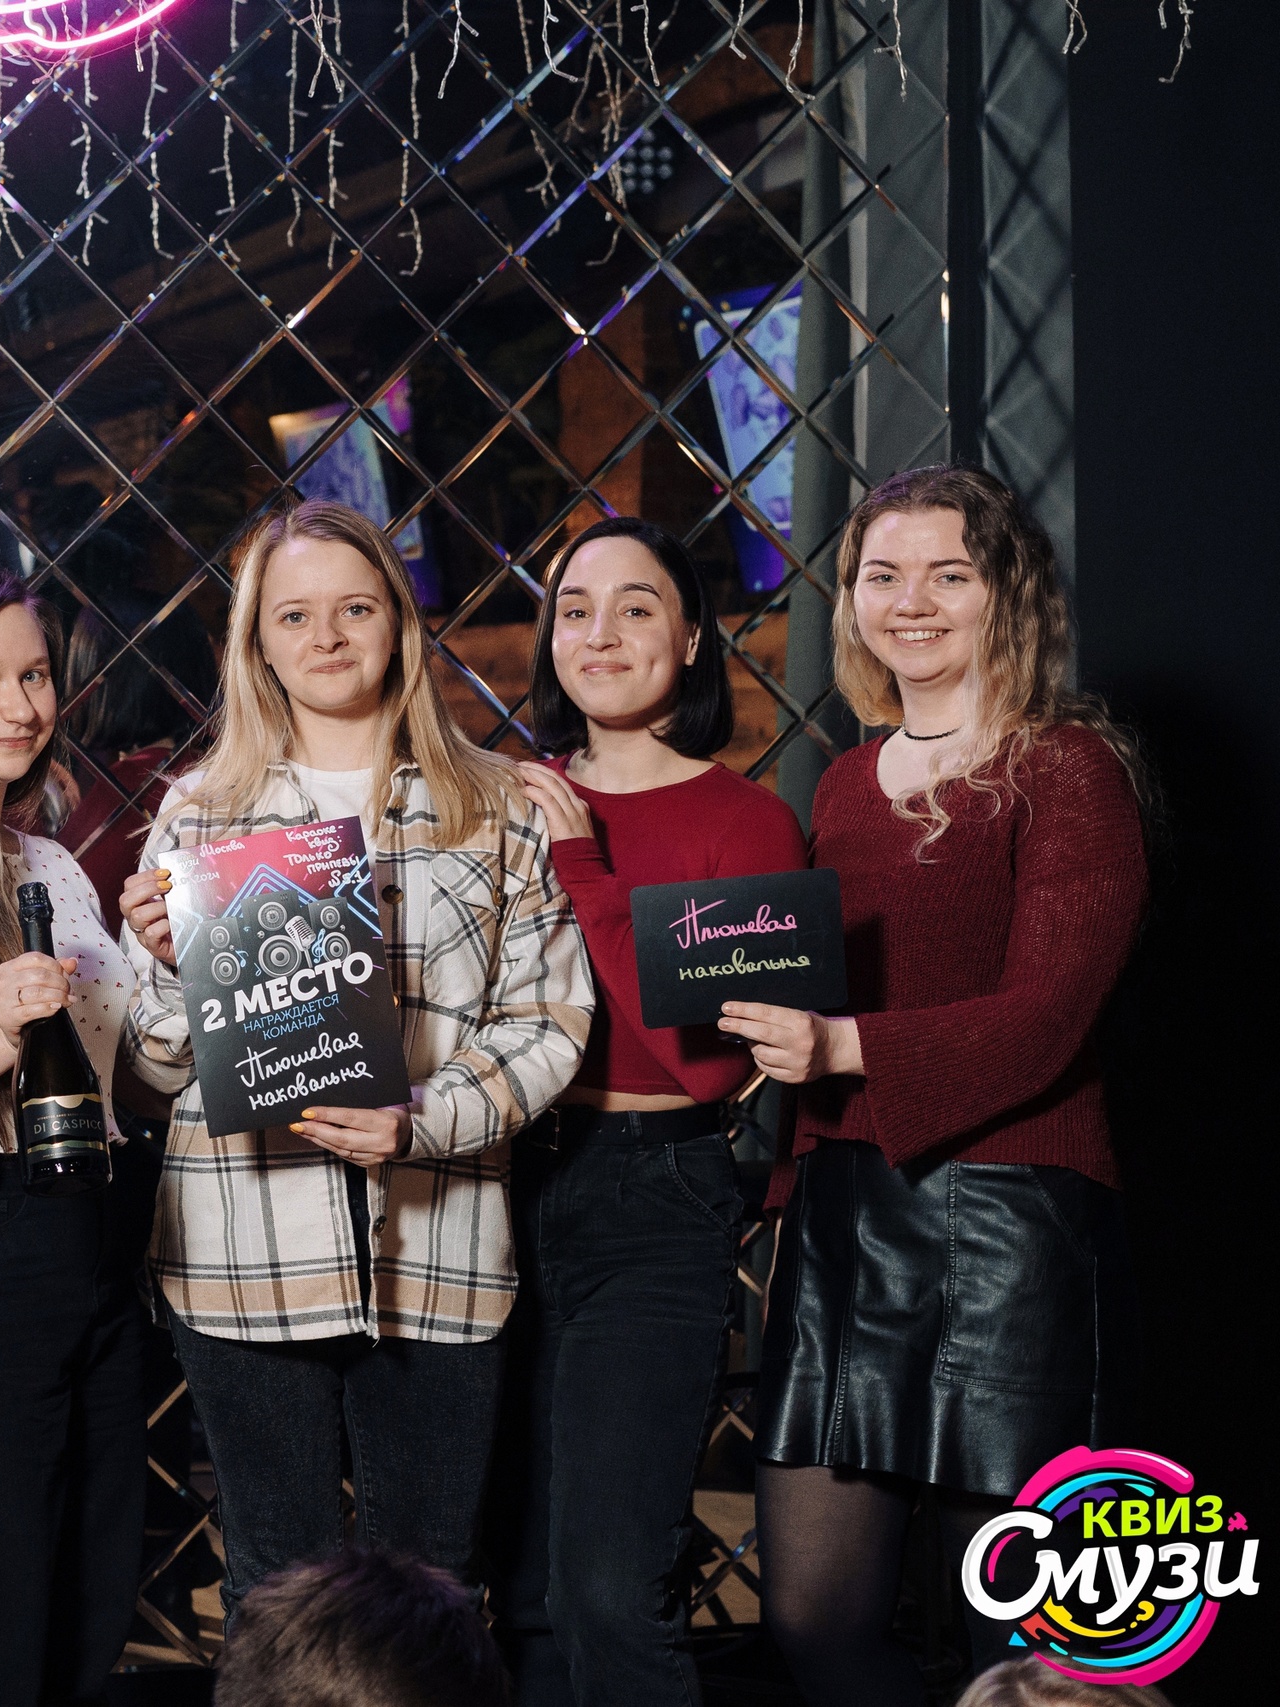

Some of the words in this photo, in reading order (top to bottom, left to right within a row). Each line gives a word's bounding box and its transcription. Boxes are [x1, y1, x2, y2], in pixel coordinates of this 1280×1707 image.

[199, 839, 246, 858] Москва
[669, 898, 798, 950] Плюшевая
[679, 947, 812, 981] наковальня
[200, 998, 227, 1033] 2
[234, 951, 374, 1023] МЕСТО
[243, 993, 340, 1033] НАГРАЖДАЕТСЯ
[262, 1012, 326, 1040] КОМАНДА
[234, 1032, 363, 1088] Плюшевая
[248, 1061, 374, 1110] наковальня
[33, 1122, 46, 1135] DI
